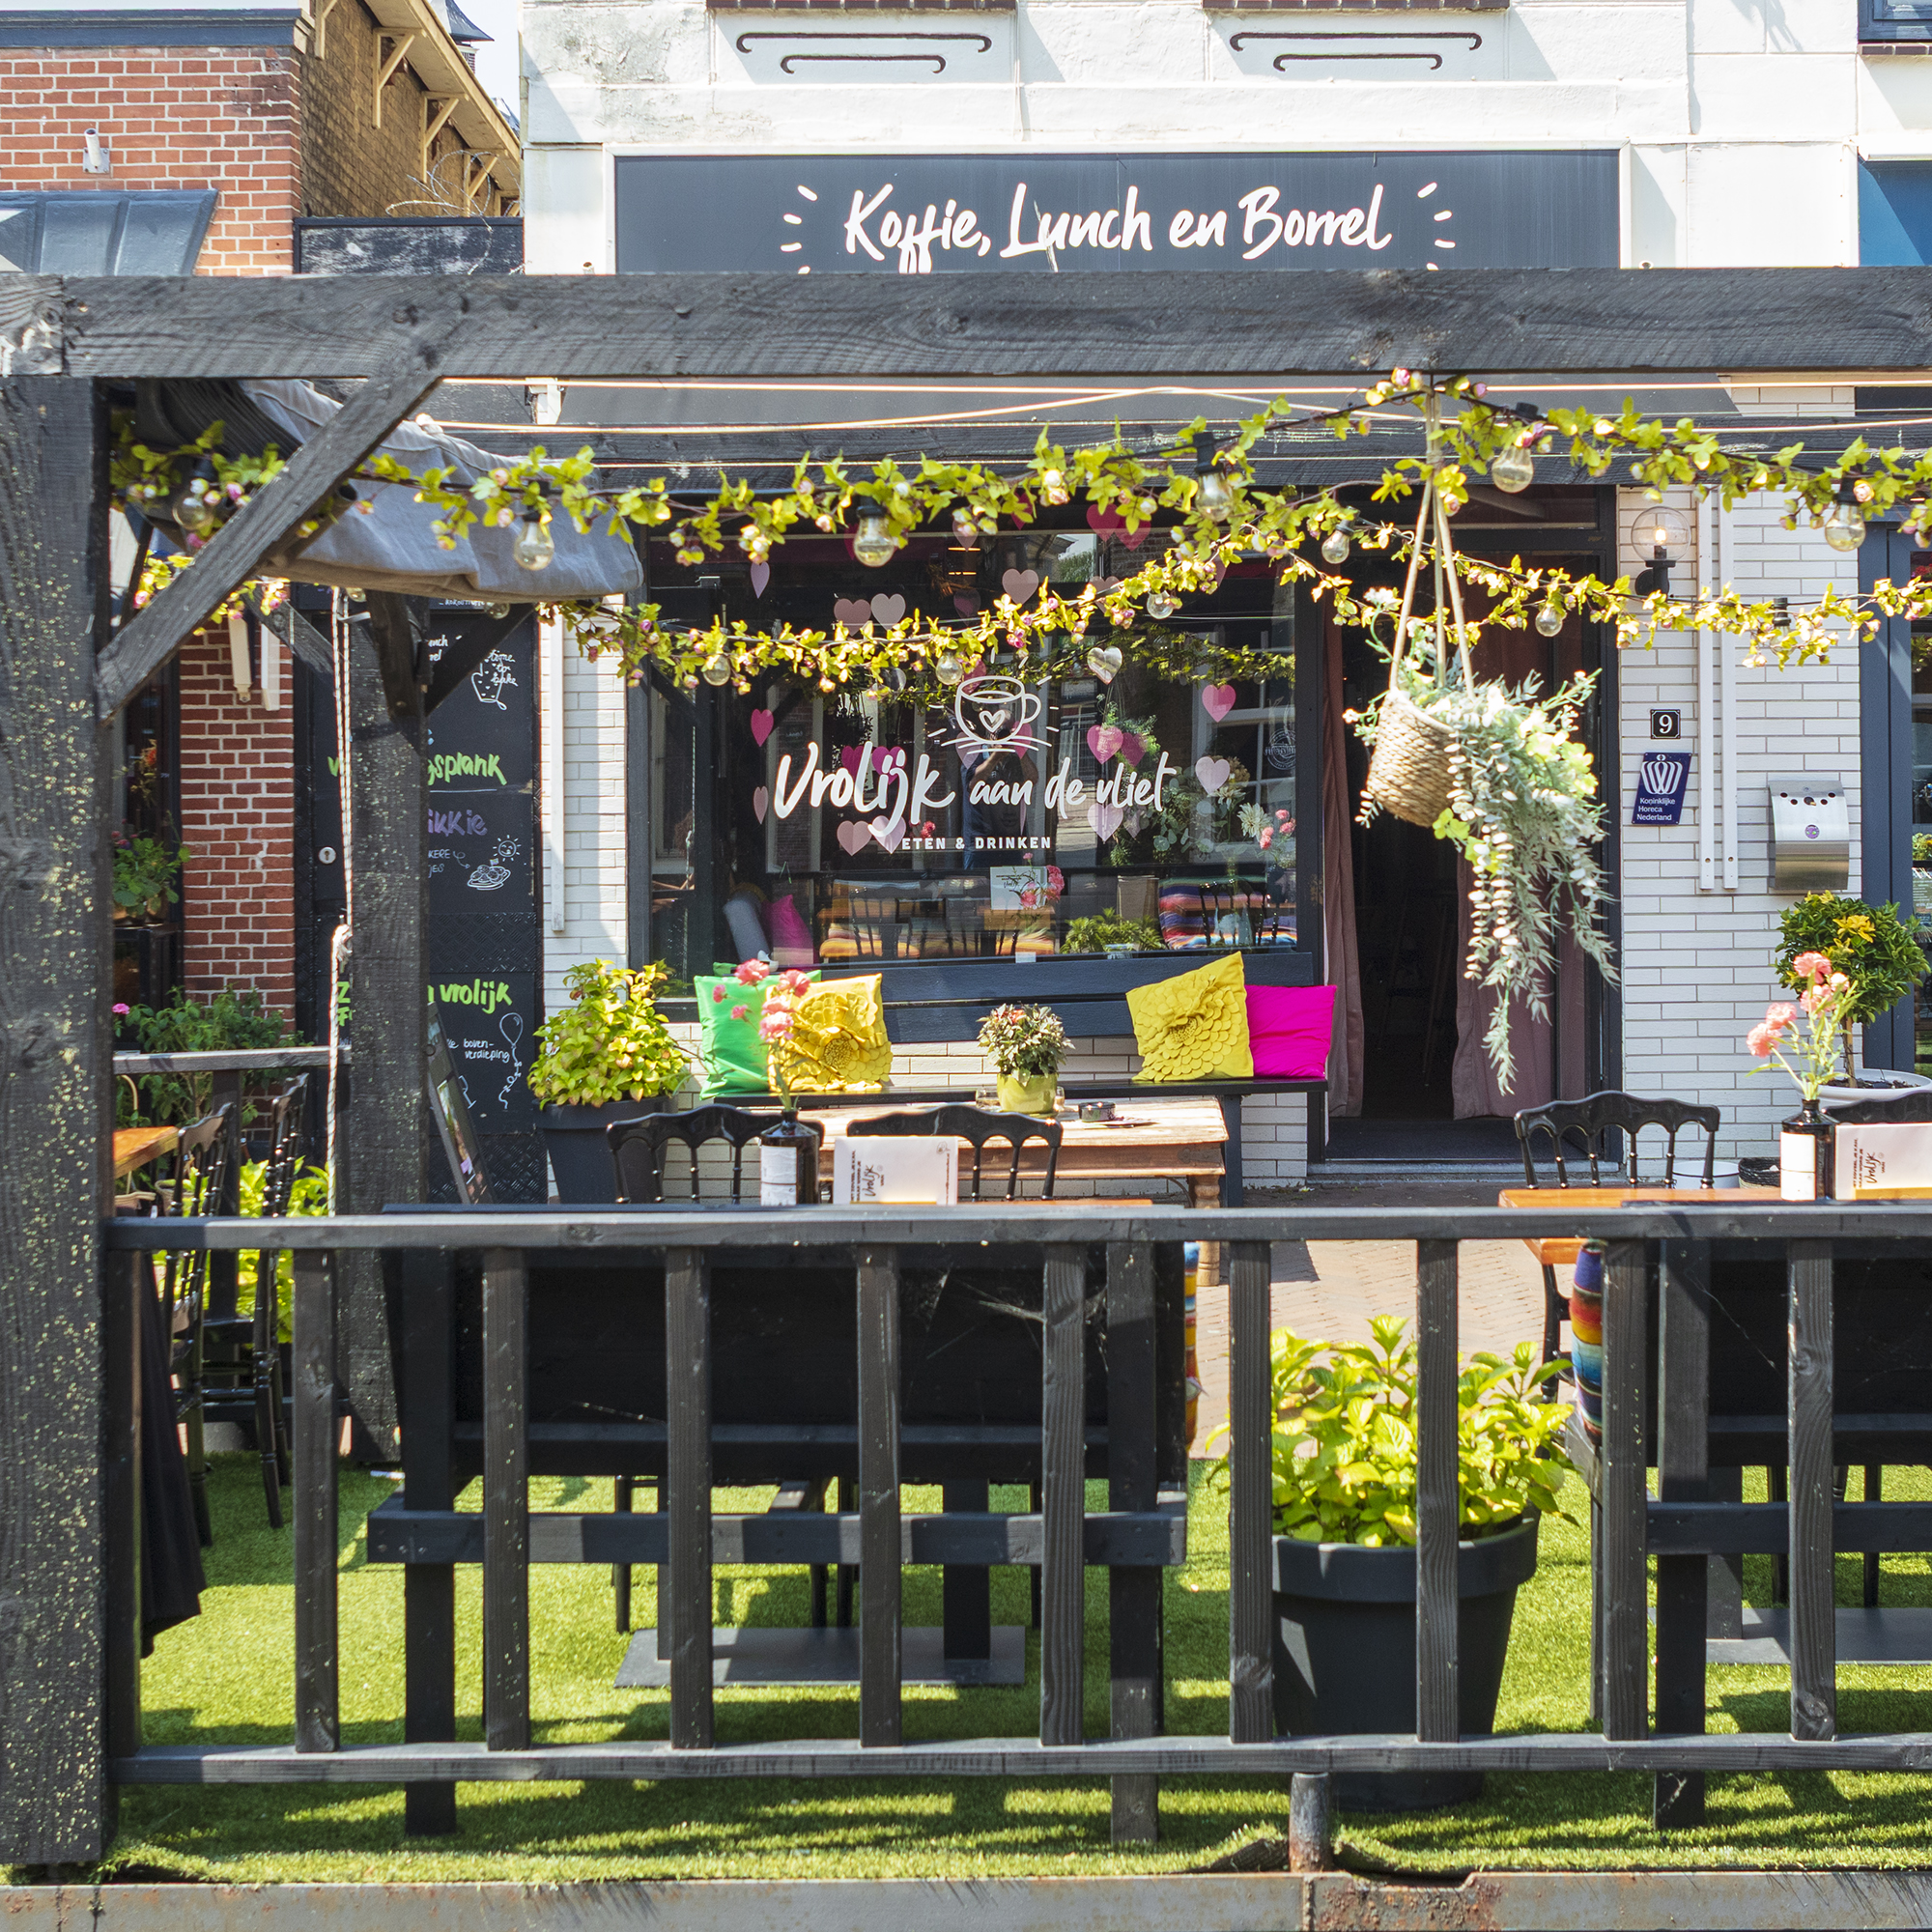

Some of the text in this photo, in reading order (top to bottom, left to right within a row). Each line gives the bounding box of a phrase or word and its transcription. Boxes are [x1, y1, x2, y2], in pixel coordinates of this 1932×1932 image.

[843, 183, 1393, 273] Koffie, Lunch en Borrel
[1659, 714, 1673, 734] 9
[774, 741, 1178, 838] Vrolijk aan de vliet
[1639, 797, 1676, 806] Koninklijke
[901, 837, 1052, 850] ETEN & DRINKEN
